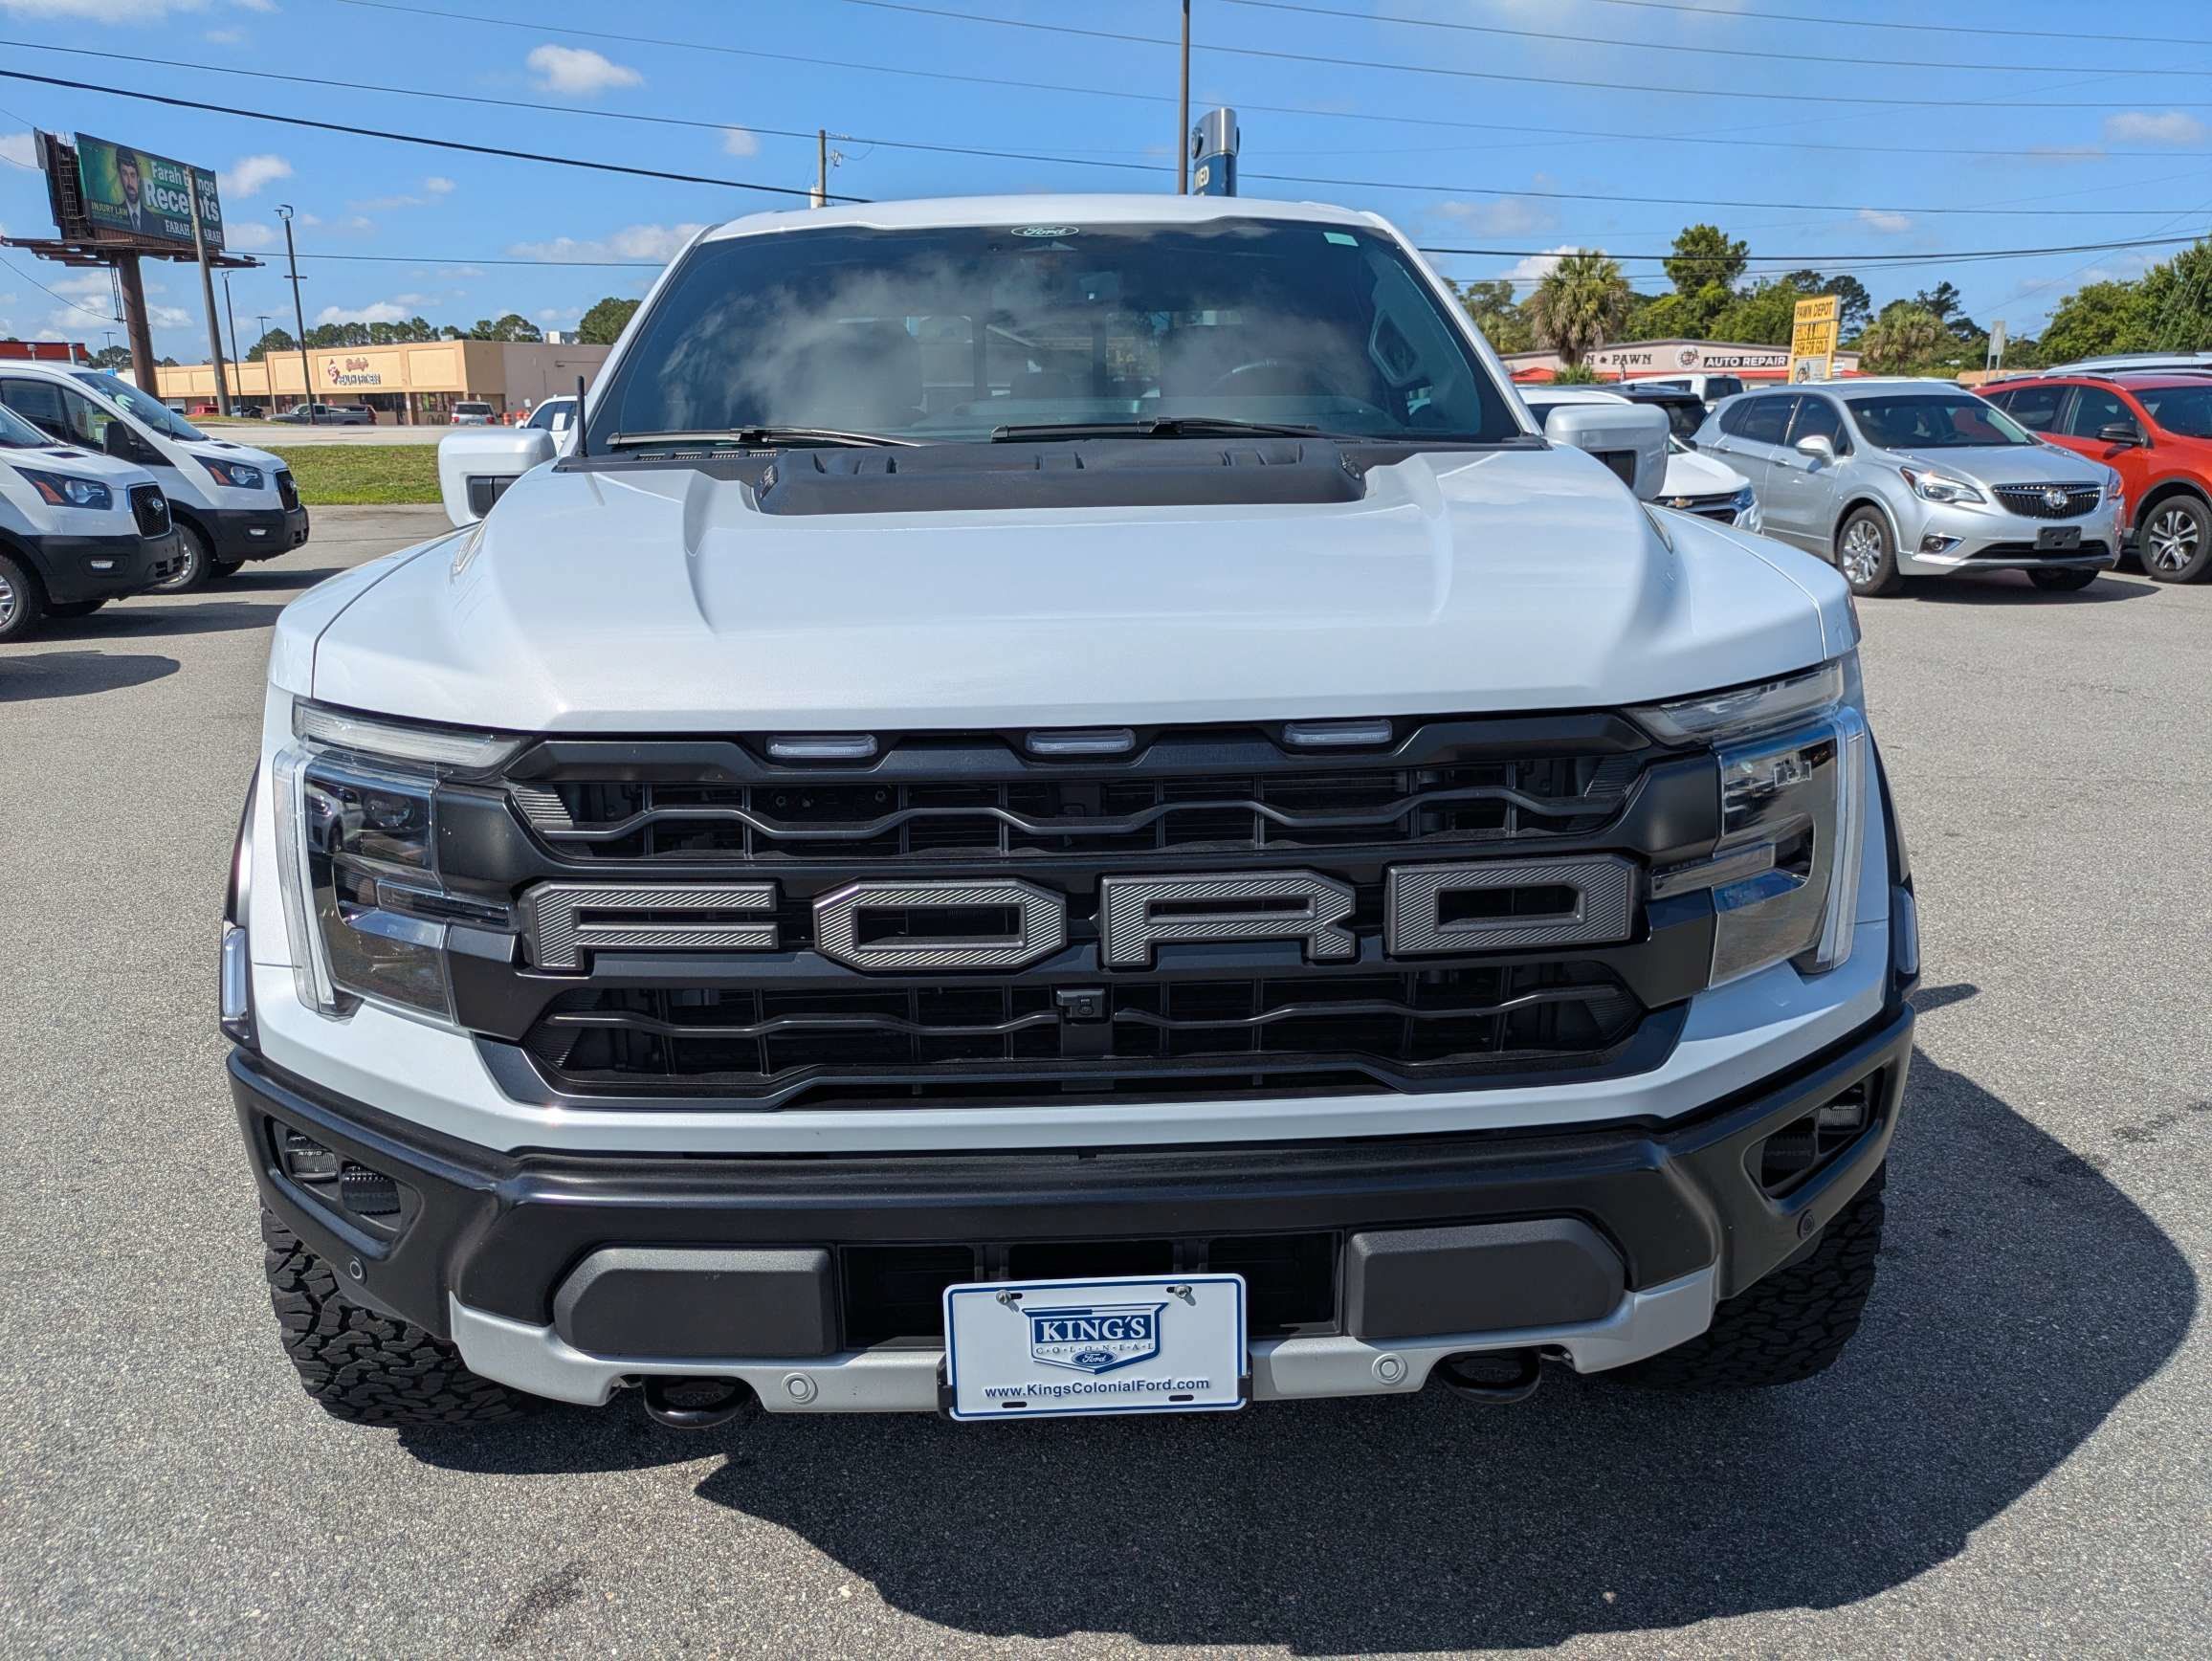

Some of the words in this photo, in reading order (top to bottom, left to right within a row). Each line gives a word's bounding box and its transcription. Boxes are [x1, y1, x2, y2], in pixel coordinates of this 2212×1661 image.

[151, 161, 182, 186] Farah
[165, 219, 191, 236] FARAH
[203, 228, 222, 243] ARAH
[1797, 304, 1812, 320] PAWN
[1813, 301, 1833, 318] DEPOT
[1611, 354, 1652, 365] PAWN
[1705, 357, 1739, 367] AUTO
[1742, 356, 1786, 366] REPAIR
[518, 854, 1633, 971] FORD
[1041, 1317, 1146, 1341] KING'S
[984, 1379, 1209, 1398] www.KingsColonialFord.com
